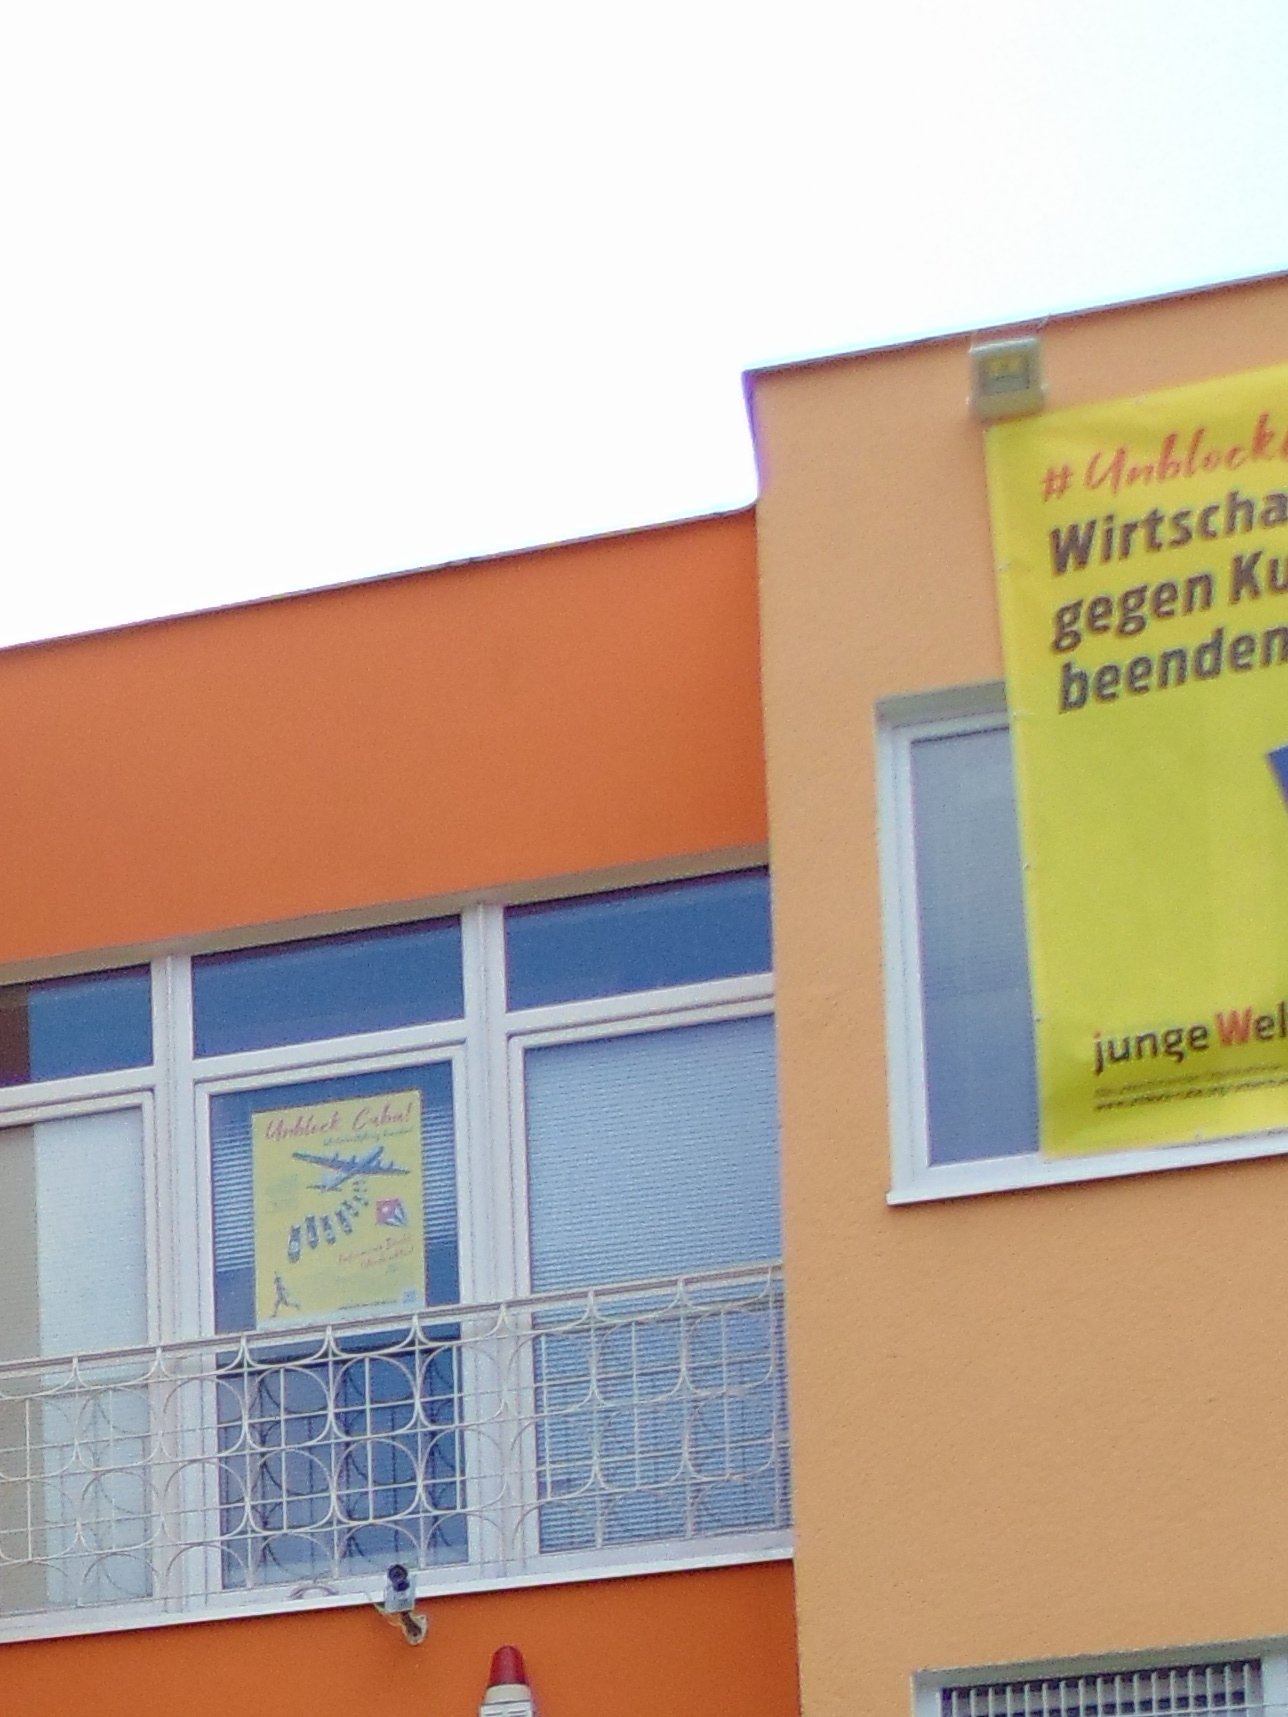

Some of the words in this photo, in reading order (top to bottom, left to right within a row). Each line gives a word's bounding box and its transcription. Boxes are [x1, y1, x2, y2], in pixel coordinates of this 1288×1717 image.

[1052, 571, 1214, 654] gegen
[1229, 549, 1288, 605] Ku
[1059, 626, 1288, 715] beenden
